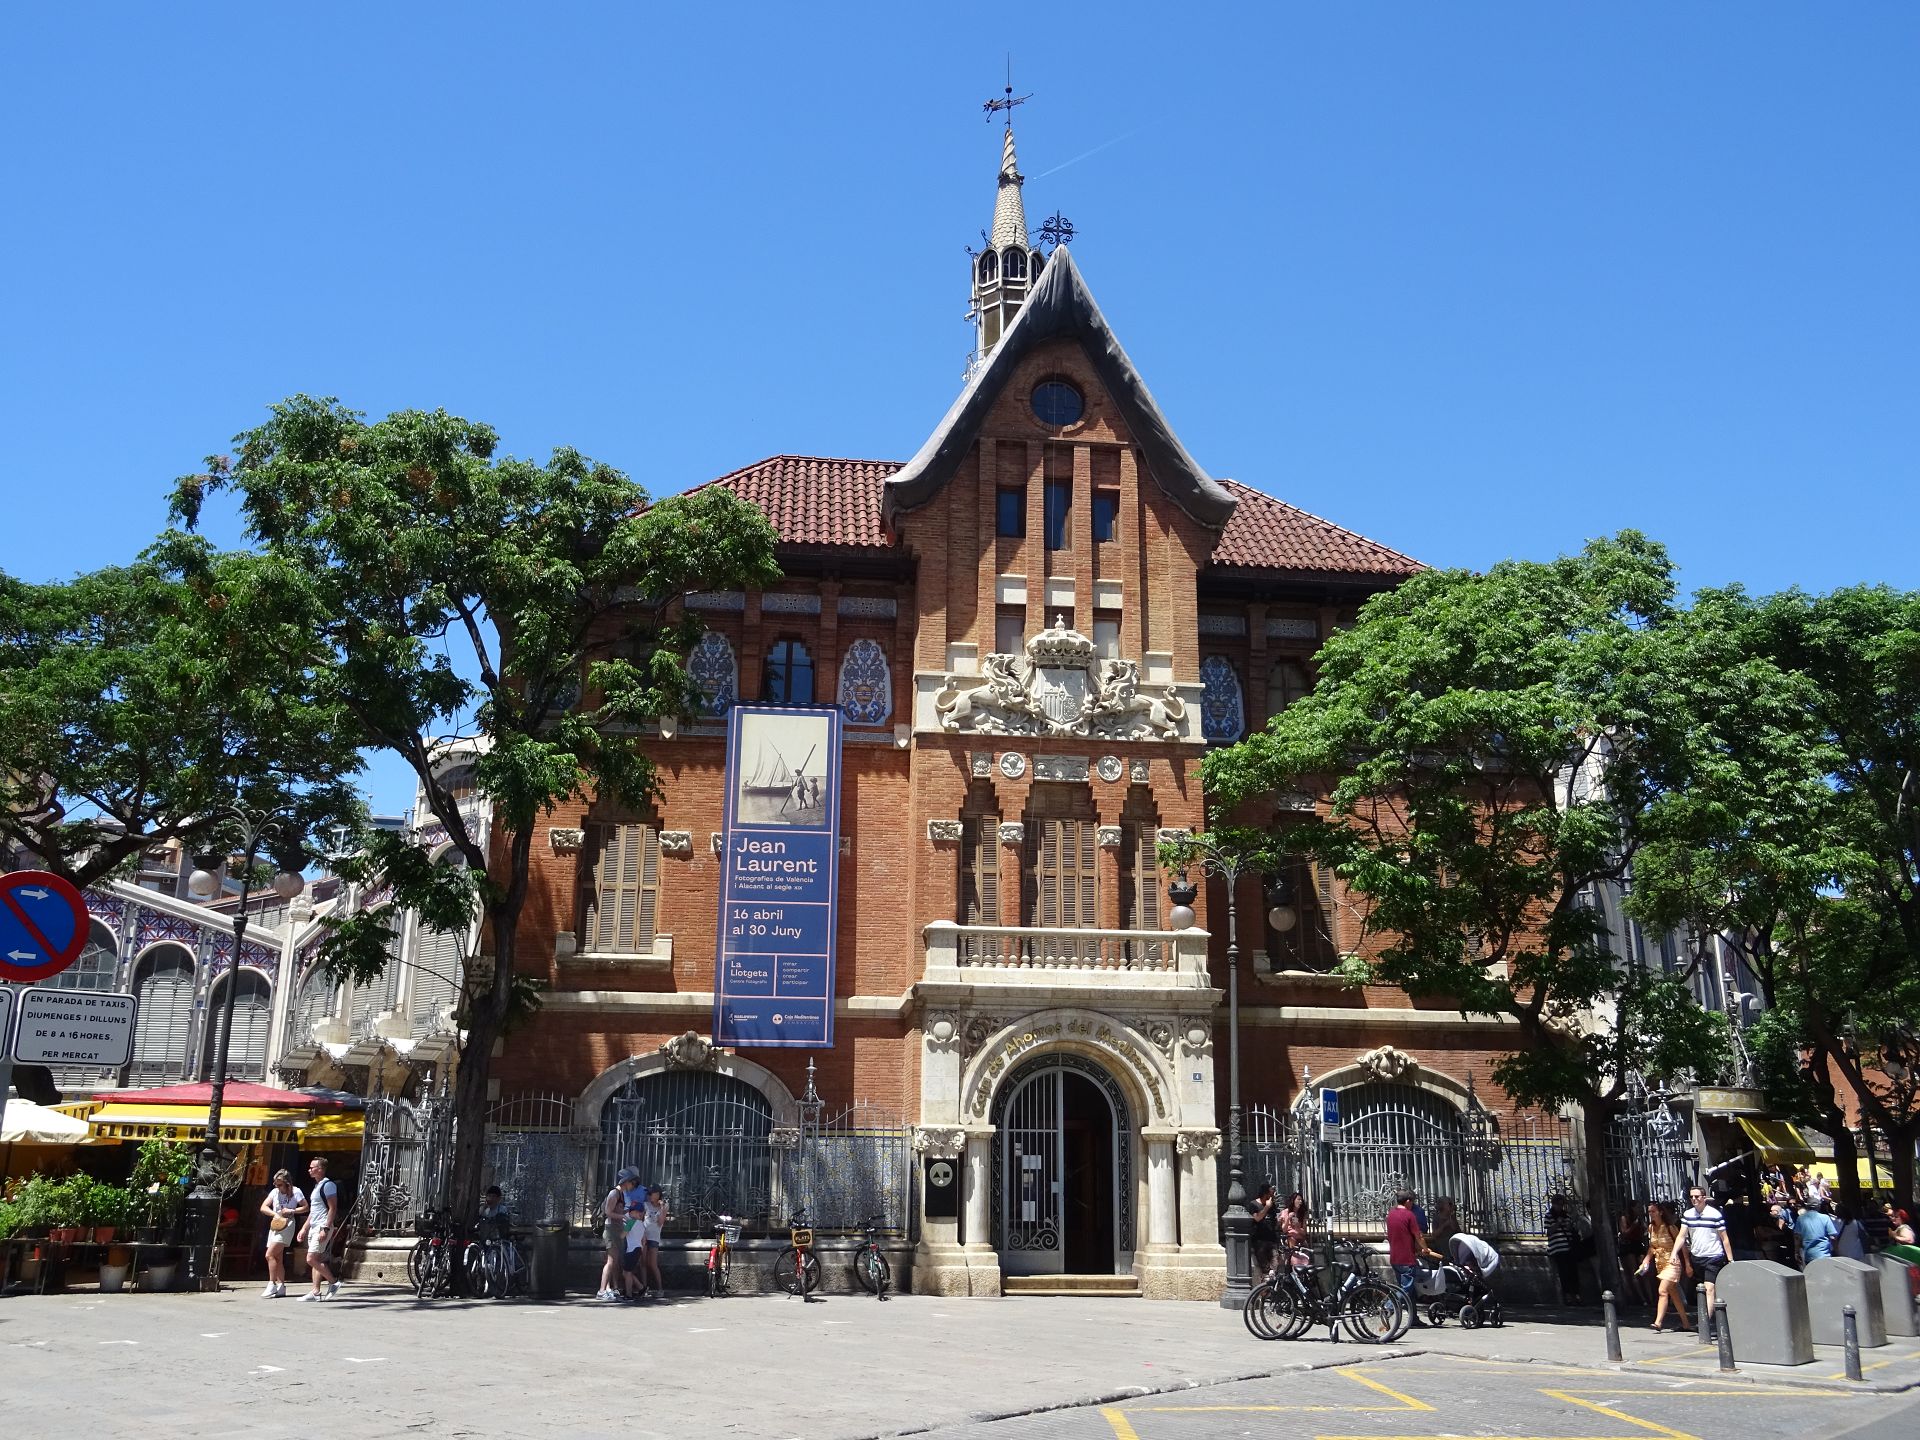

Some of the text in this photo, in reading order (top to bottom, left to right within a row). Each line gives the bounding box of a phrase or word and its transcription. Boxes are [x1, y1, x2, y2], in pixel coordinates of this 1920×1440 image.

[736, 837, 785, 854] Jean
[737, 855, 818, 873] Laurent
[735, 875, 773, 883] Fotografies
[733, 908, 783, 920] 16 abril
[732, 924, 802, 939] al 30 Juny
[731, 960, 742, 968] La
[730, 969, 768, 978] Llotgeta
[46, 997, 83, 1006] PARADA
[100, 1000, 129, 1009] TAXIS.
[27, 1011, 81, 1021] DIUMENGES
[89, 1015, 127, 1024] DILLUNS
[69, 1031, 78, 1039] 16
[42, 1050, 99, 1059] PER MERCAT
[972, 1075, 993, 1118] Caja
[988, 1055, 1006, 1078] de
[1004, 1021, 1062, 1057] Ahorros
[1067, 1019, 1093, 1034] del
[1323, 1101, 1338, 1113] TAXI
[189, 1126, 299, 1142] MNOLITA
